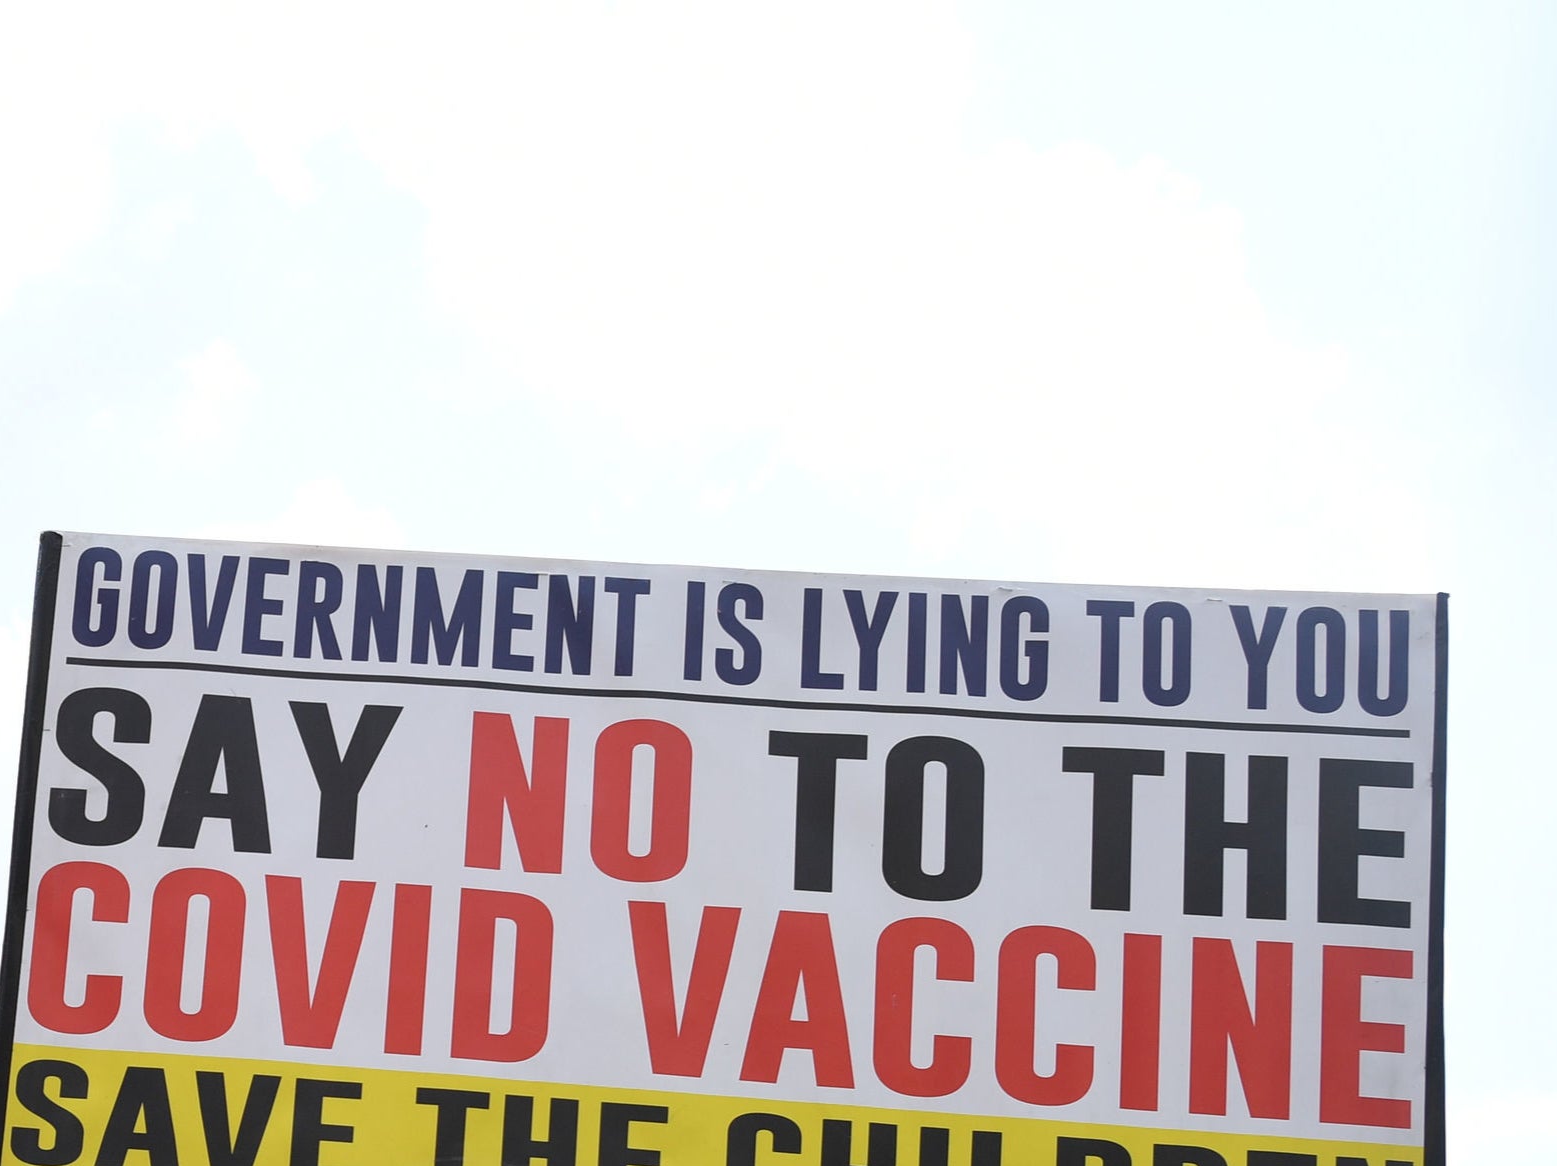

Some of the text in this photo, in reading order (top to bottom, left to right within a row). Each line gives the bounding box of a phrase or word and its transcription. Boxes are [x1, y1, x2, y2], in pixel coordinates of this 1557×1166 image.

[71, 547, 1410, 717] GOVERNMENT IS LYING TO YOU
[48, 687, 1414, 929] SAY NO TO THE
[27, 861, 1414, 1129] COVID VACCINE
